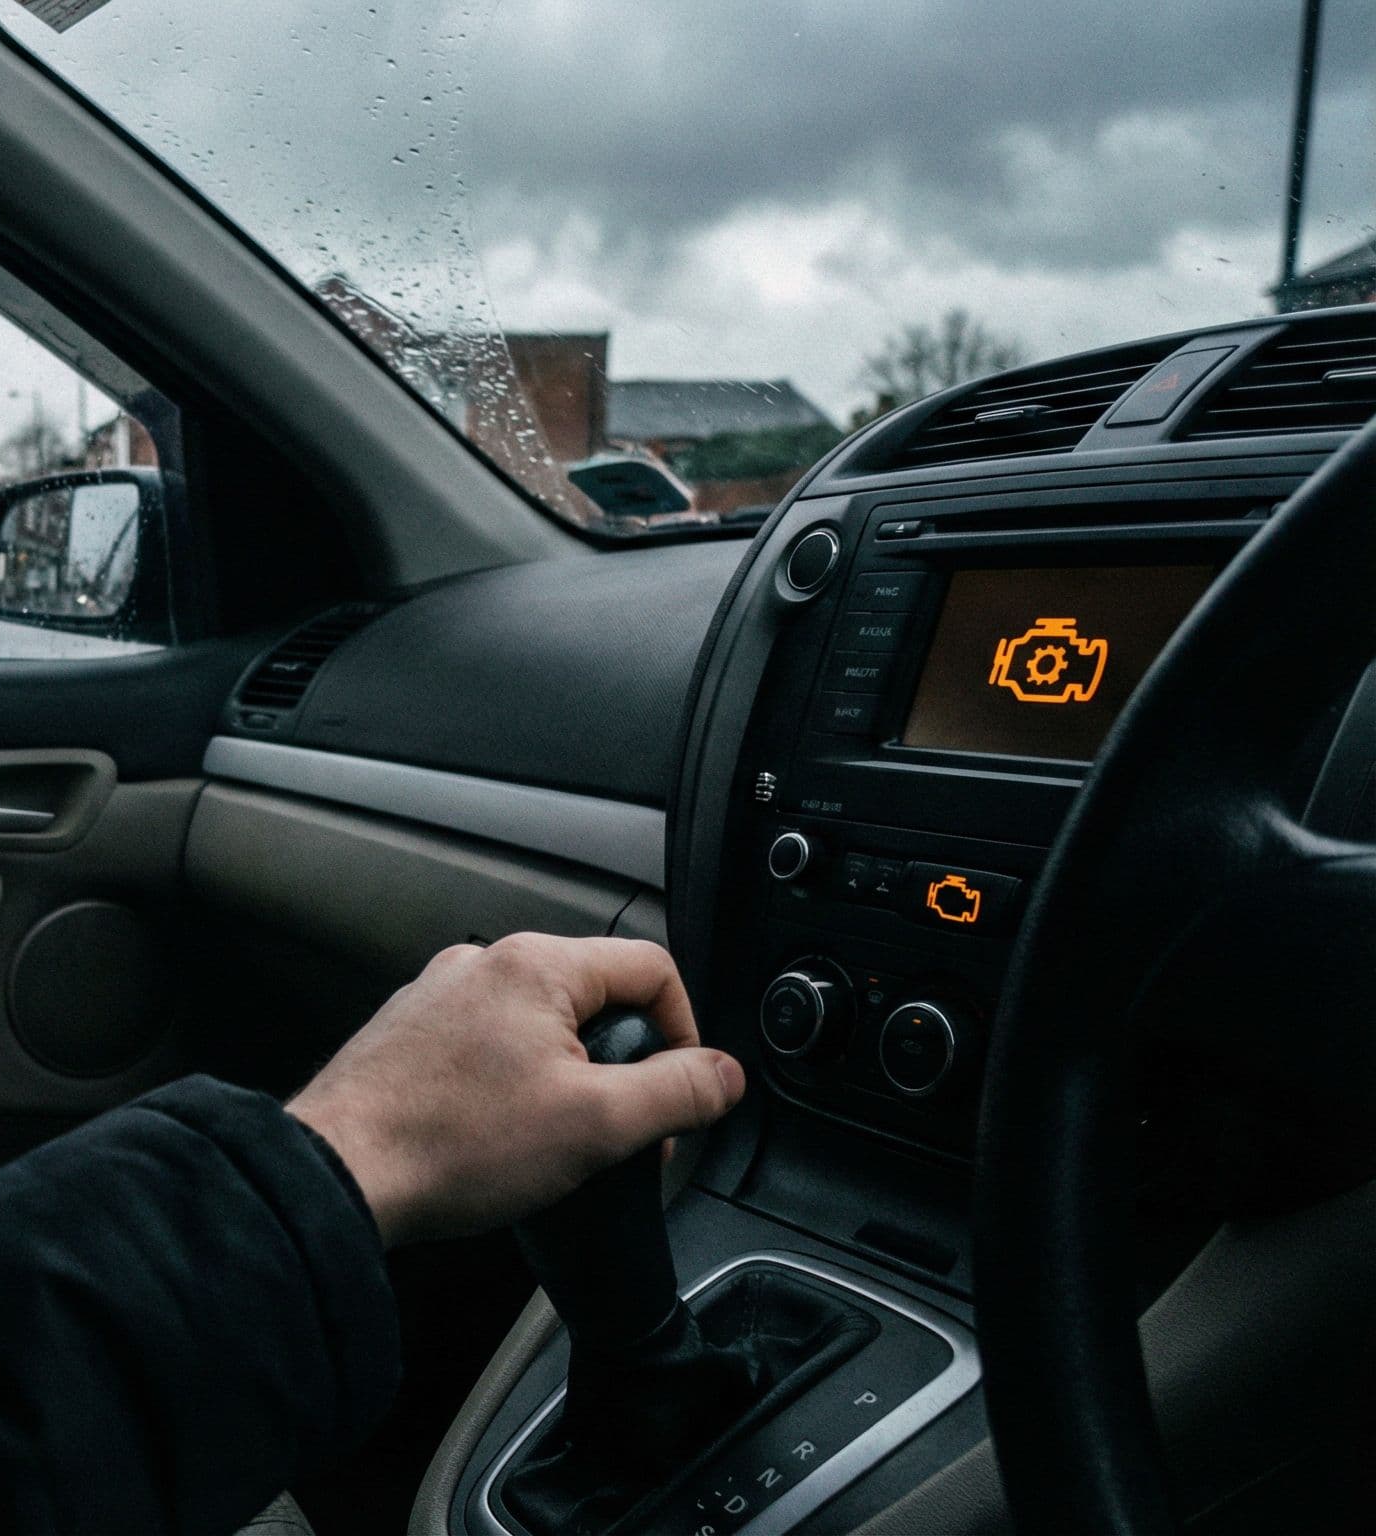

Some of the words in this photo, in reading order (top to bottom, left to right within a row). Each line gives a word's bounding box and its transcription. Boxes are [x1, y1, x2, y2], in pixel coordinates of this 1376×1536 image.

[853, 1391, 877, 1405] P
[792, 1440, 816, 1460] R
[756, 1467, 783, 1488] N
[724, 1495, 746, 1514] D
